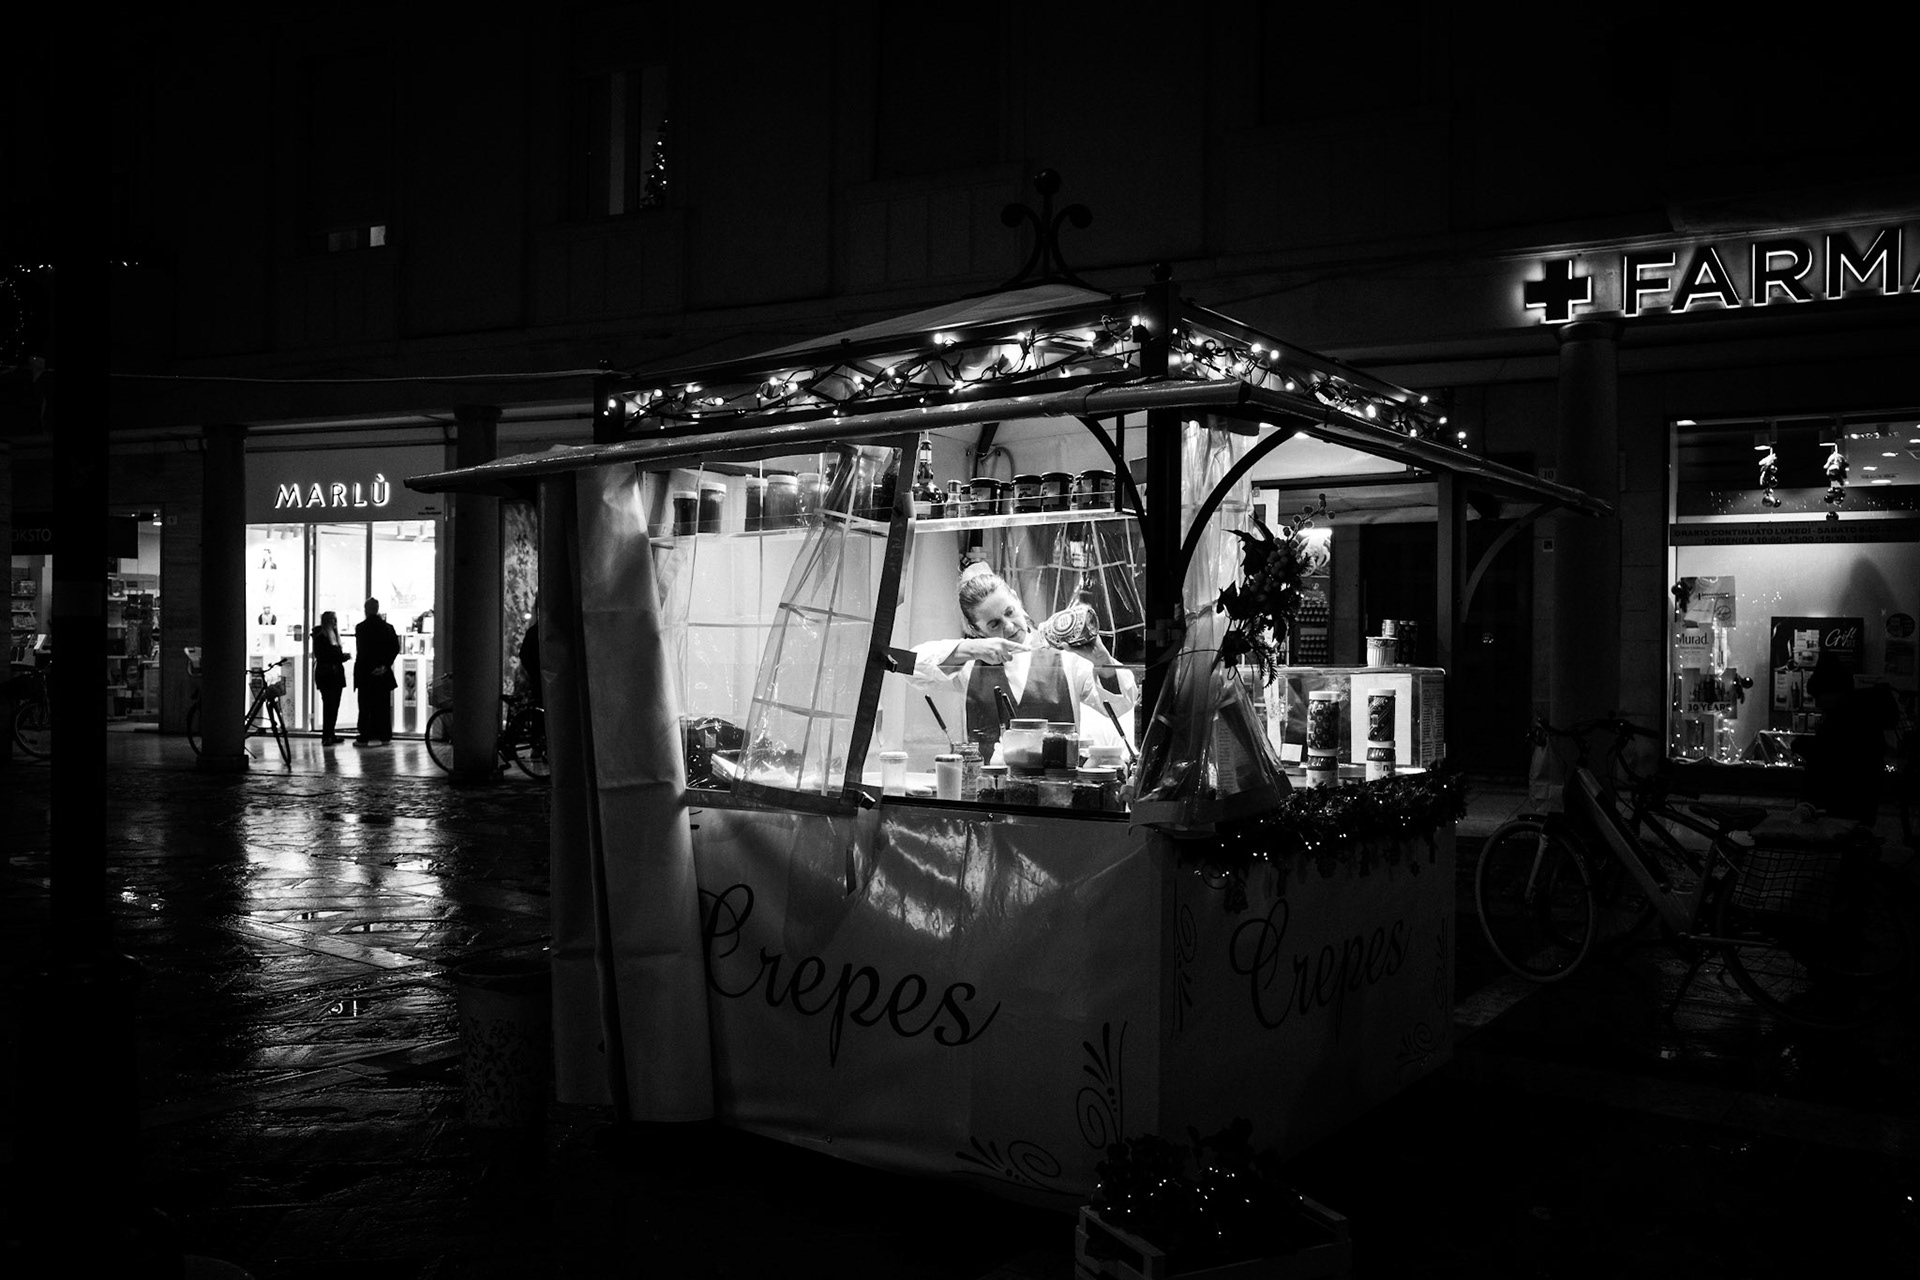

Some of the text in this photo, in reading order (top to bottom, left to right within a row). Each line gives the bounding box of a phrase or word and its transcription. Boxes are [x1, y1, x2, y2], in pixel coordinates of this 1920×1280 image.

[1623, 228, 1920, 318] FARM
[274, 473, 391, 510] MARLÙ
[1674, 529, 1710, 538] ORARIO
[1711, 527, 1773, 537] CONTINUATO
[1817, 526, 1857, 535] SABATO
[1704, 536, 1754, 545] DOMENICA
[1825, 626, 1857, 647] Gift
[1688, 703, 1731, 712] 30 YEARS
[699, 882, 1002, 1067] Crepes
[1229, 898, 1412, 1044] Crepes
